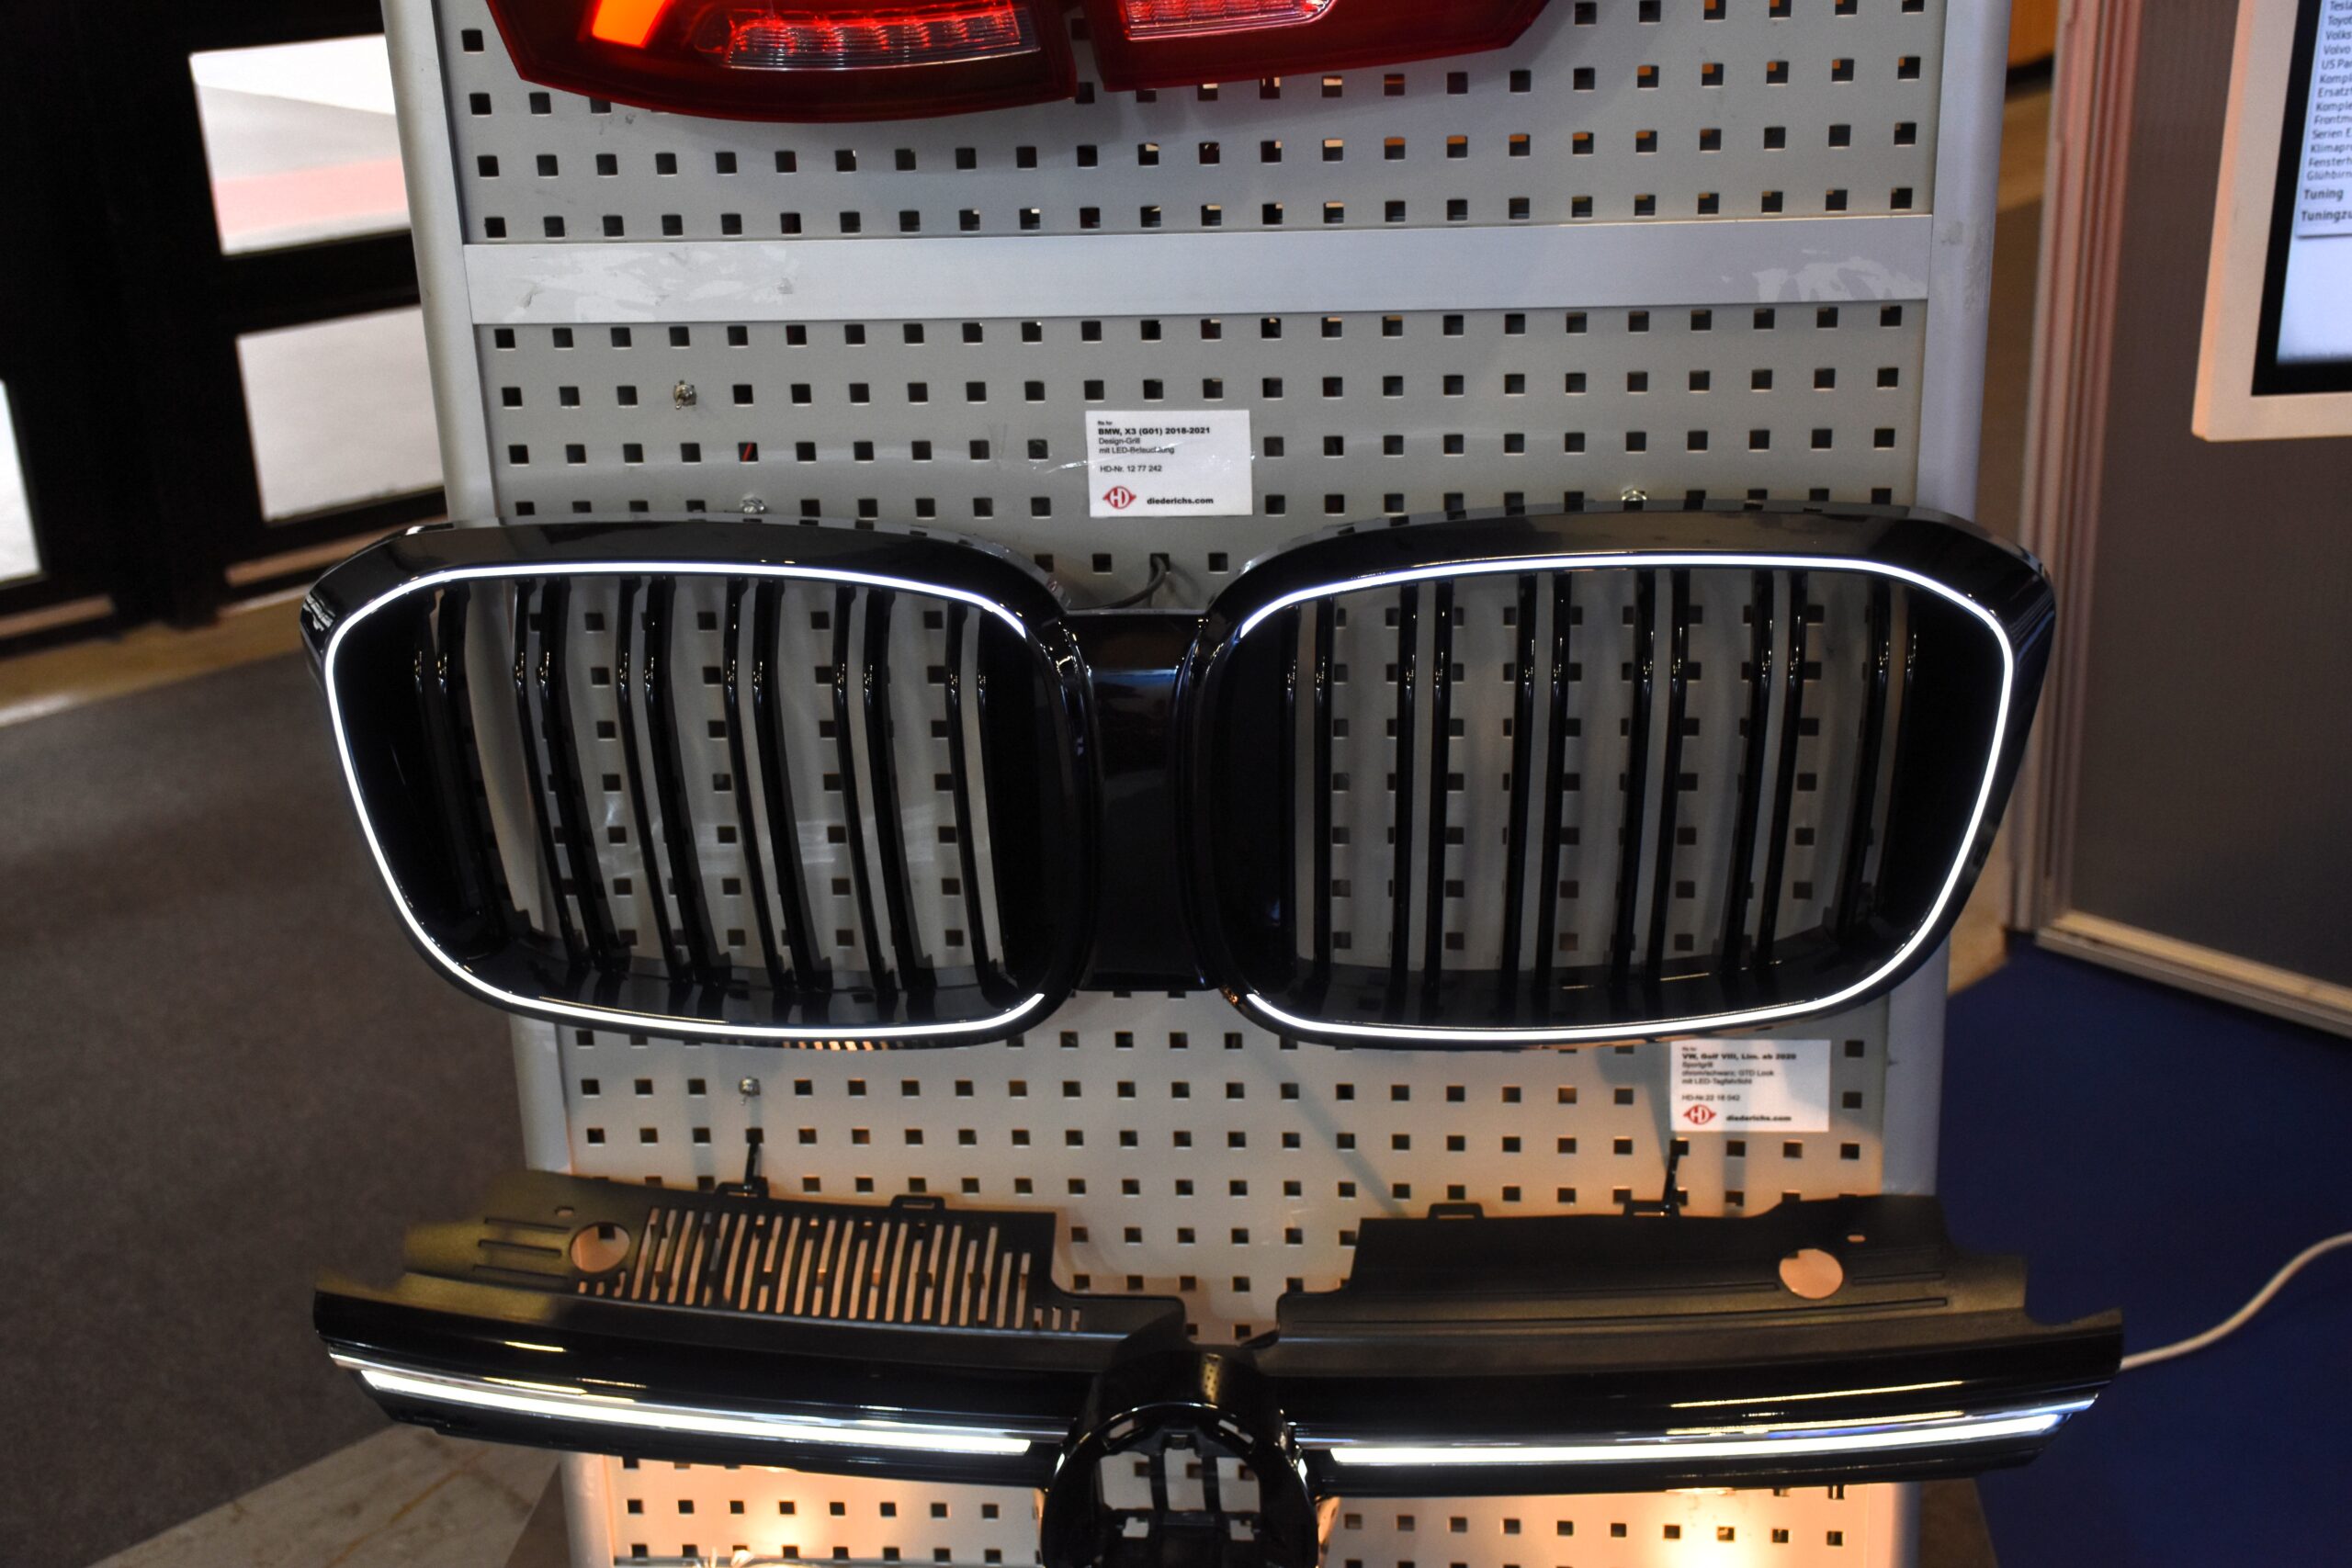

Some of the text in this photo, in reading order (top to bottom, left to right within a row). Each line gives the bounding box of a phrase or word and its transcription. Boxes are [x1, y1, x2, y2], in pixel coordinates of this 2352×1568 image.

[2324, 43, 2351, 55] Volvo
[2321, 58, 2335, 70] US
[2312, 130, 2343, 140] Serien
[2304, 187, 2344, 202] Tuning
[1098, 428, 1122, 436] BMW,
[1139, 427, 1162, 435] (G01)
[1165, 426, 1210, 434] 2018-2021
[1099, 437, 1140, 446] Design-Grill
[1147, 496, 1214, 505] diederichs.com
